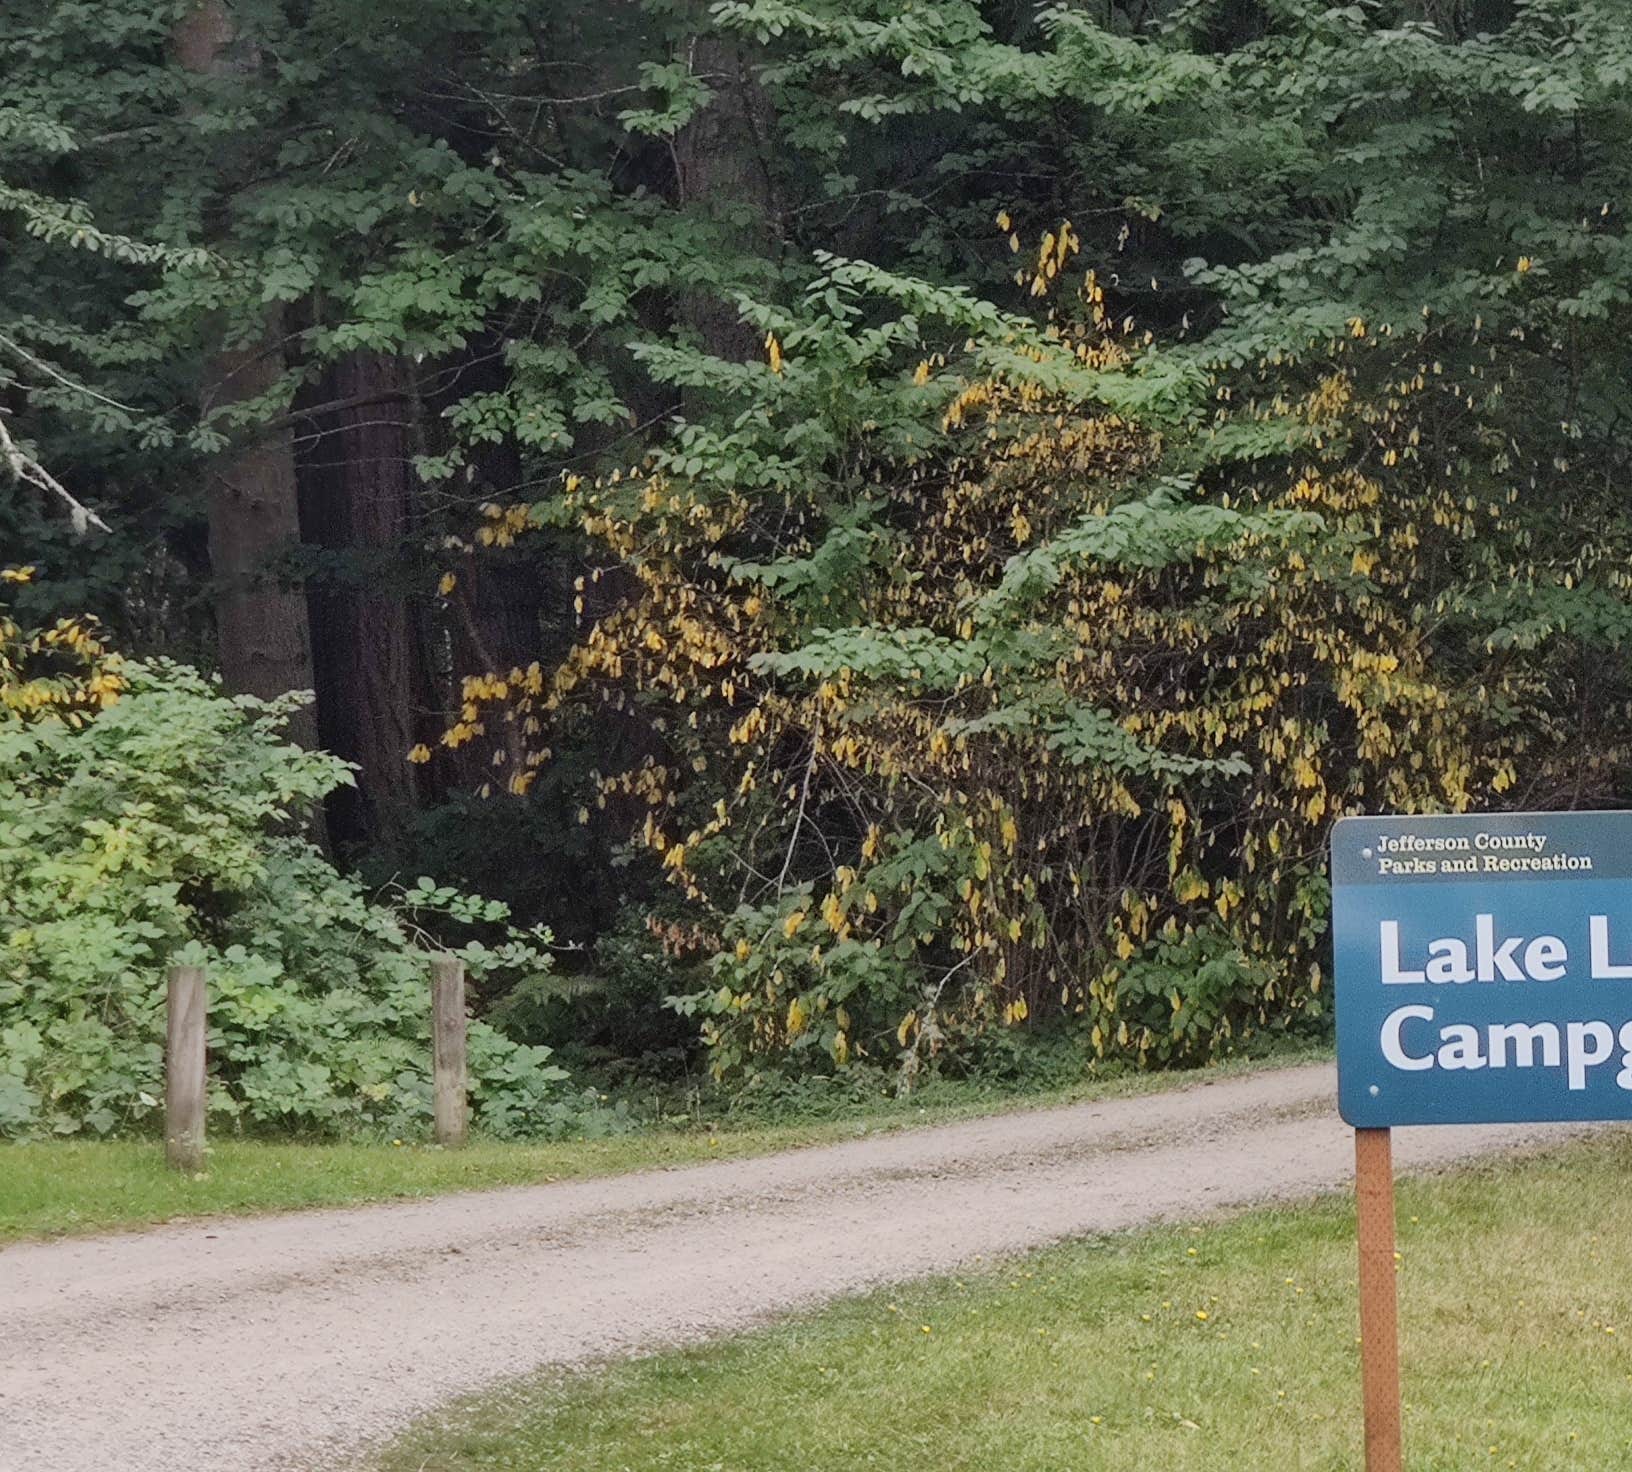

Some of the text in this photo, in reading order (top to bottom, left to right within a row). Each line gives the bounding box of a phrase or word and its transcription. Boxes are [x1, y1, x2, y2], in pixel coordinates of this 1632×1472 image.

[1377, 832, 1547, 853] Jefferson County
[1378, 853, 1592, 874] Parks and Recreation
[1380, 914, 1568, 984] Lake
